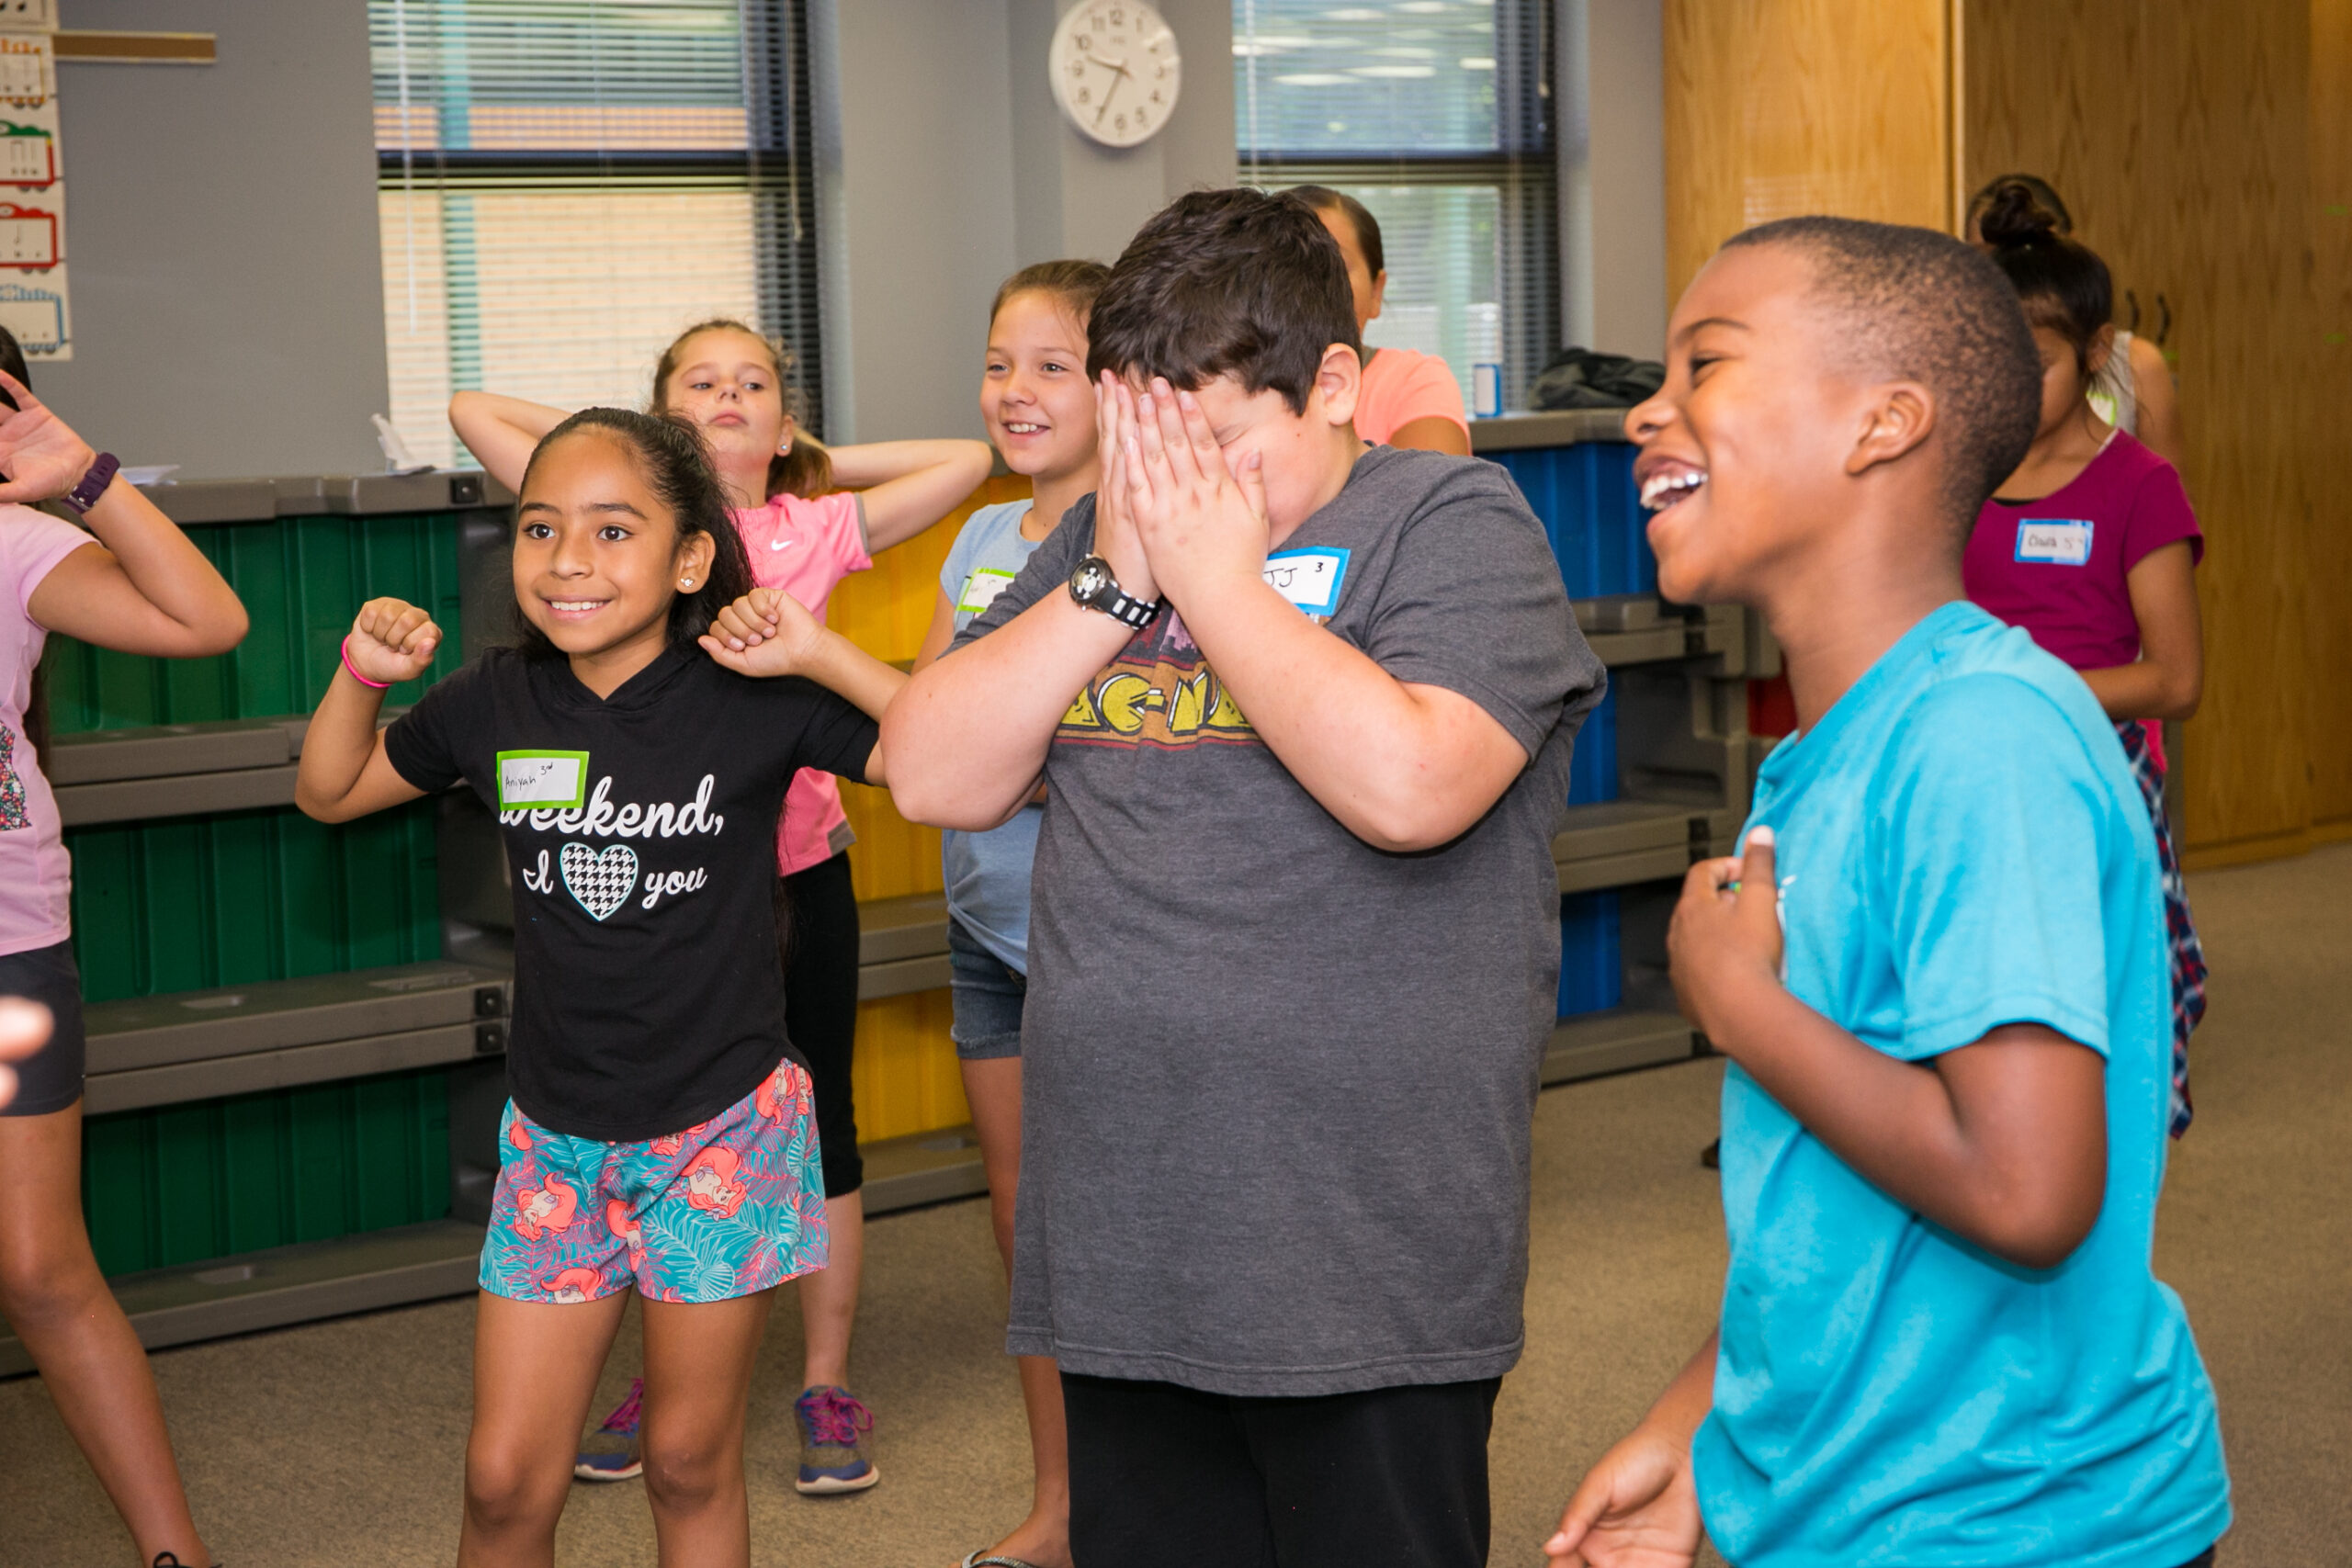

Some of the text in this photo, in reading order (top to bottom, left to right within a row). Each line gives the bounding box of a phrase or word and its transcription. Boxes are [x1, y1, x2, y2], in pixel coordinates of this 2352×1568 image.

[1091, 17, 1105, 31] 11
[1109, 8, 1125, 26] 12
[1136, 17, 1144, 32] 1
[1075, 34, 1092, 51] 10
[1072, 60, 1085, 78] 9
[1079, 86, 1091, 104] 8
[1114, 113, 1127, 130] 6
[1315, 561, 1324, 572] 3
[642, 867, 707, 909] you
